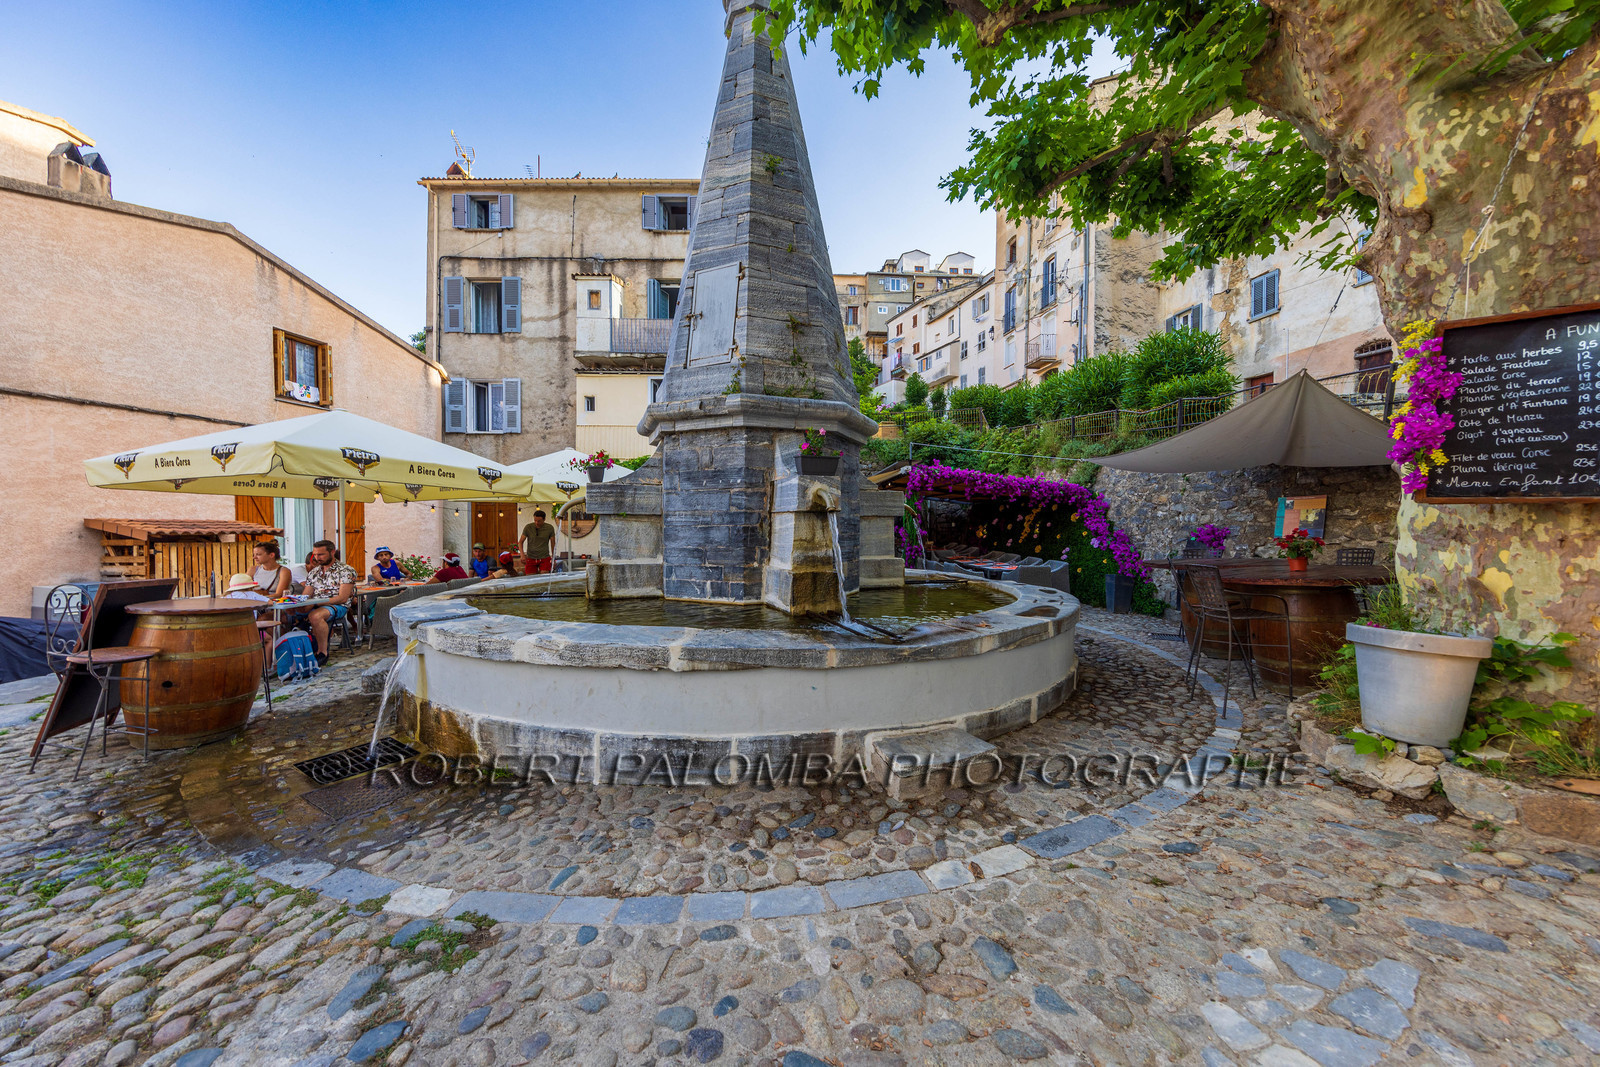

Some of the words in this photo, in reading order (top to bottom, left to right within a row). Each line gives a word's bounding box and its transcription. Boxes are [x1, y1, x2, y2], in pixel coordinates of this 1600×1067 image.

[1545, 328, 1556, 340] A
[1461, 354, 1490, 364] tarte
[1522, 346, 1563, 358] herbes
[1577, 339, 1598, 350] 9,5
[1461, 365, 1498, 375] Salade
[1577, 351, 1593, 361] 12
[1502, 372, 1527, 380] Corse
[1577, 362, 1591, 371] 15
[1458, 384, 1501, 394] Planche
[1527, 377, 1563, 387] terroir
[1459, 394, 1495, 403] Planche
[1457, 407, 1494, 417] Burger
[1498, 402, 1518, 412] d'A
[1522, 398, 1568, 408] Funtana
[1488, 416, 1500, 424] de
[1507, 414, 1545, 423] Manzu
[1457, 429, 1485, 443] Gigot
[1492, 426, 1544, 438] d'agneau
[345, 448, 377, 460] Pietra
[1451, 454, 1475, 462] Filet
[1477, 453, 1489, 461] de
[1522, 447, 1552, 458] Corse
[1575, 443, 1599, 452] 25€
[154, 458, 159, 468] A
[161, 457, 174, 468] Biera
[176, 456, 191, 466] Corsa
[1451, 465, 1487, 474] Pluma
[1493, 462, 1539, 474] ibérique
[1573, 458, 1597, 468] 23€
[409, 464, 415, 474] A
[417, 465, 435, 476] Biera
[437, 468, 455, 479] Corsa
[1446, 476, 1492, 487] Menu
[1499, 473, 1564, 491] Enfant
